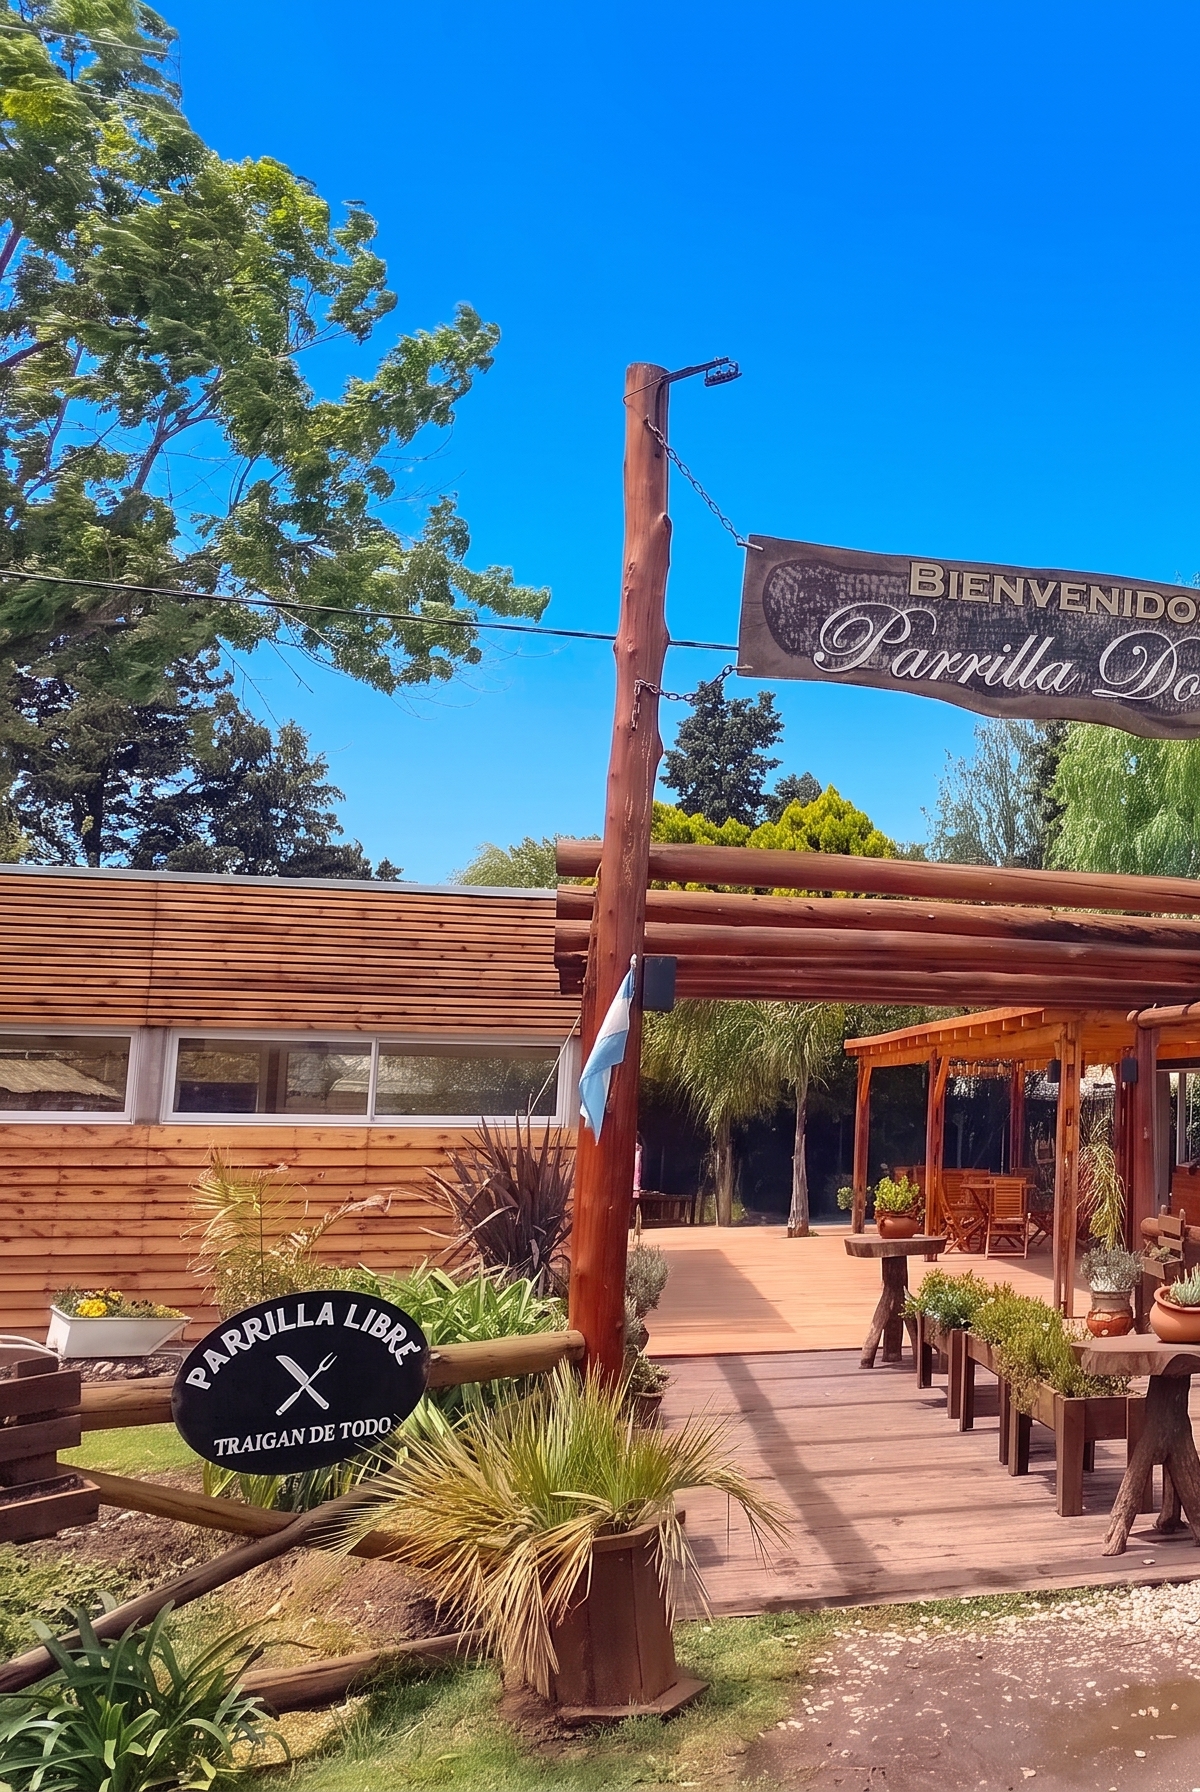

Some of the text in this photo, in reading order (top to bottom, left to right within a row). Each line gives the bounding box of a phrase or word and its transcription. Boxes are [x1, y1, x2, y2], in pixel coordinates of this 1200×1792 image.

[813, 602, 1079, 692] Parrilla
[184, 1301, 422, 1390] PARRILLA LIBRE
[213, 1416, 392, 1457] TRAIGAN DE TODO
